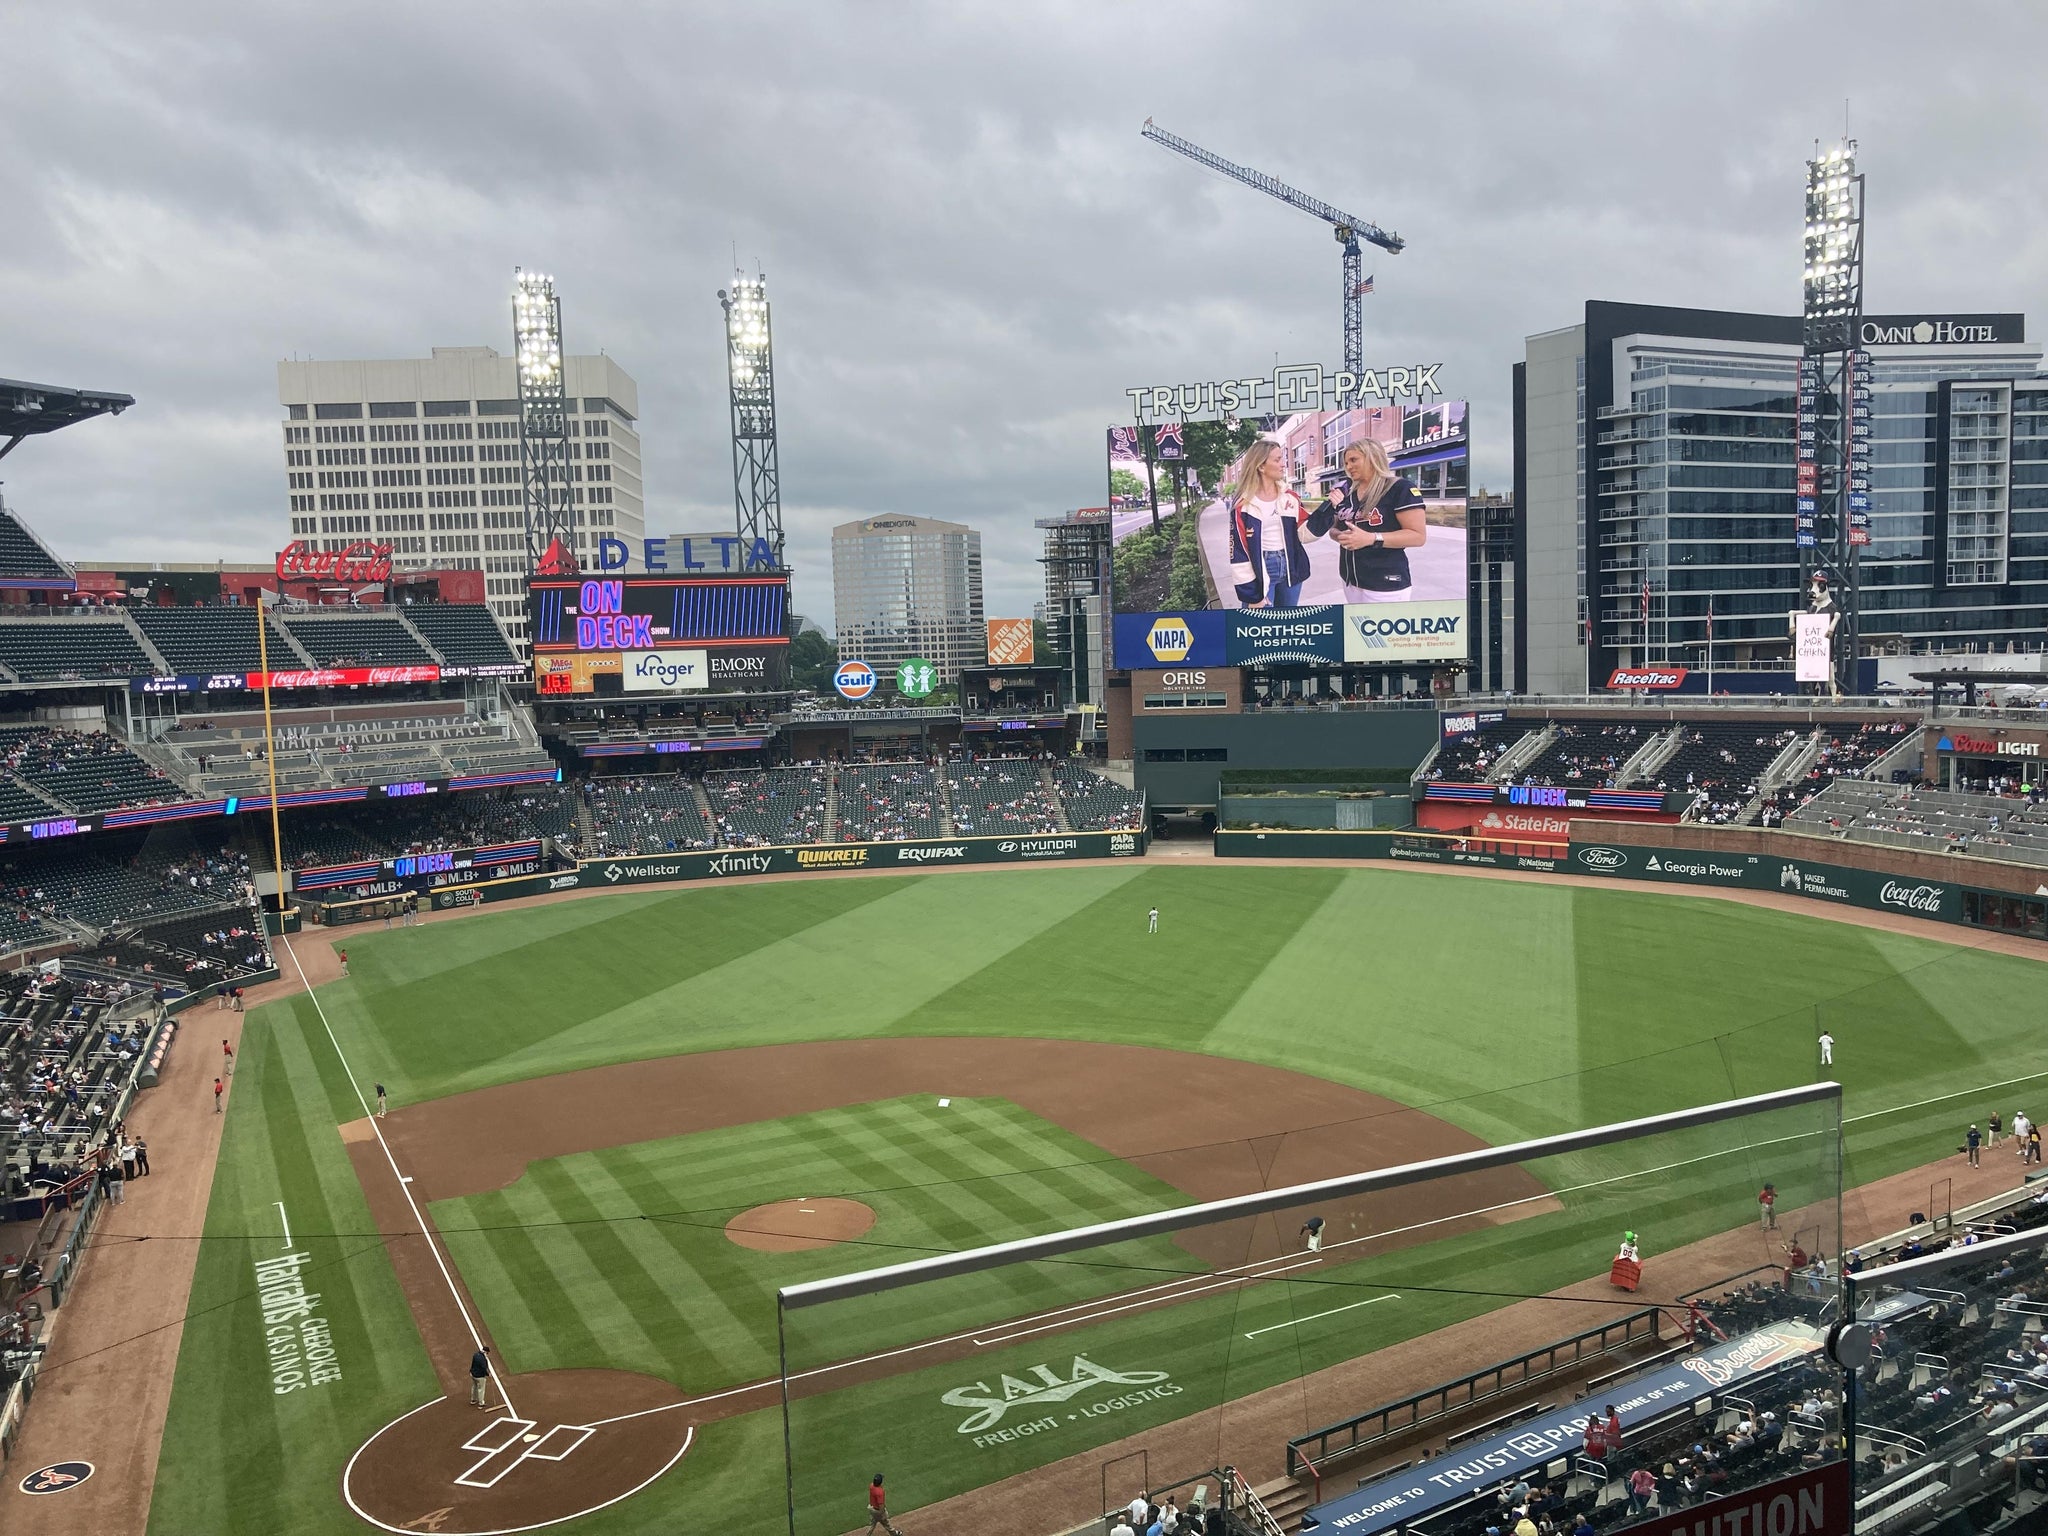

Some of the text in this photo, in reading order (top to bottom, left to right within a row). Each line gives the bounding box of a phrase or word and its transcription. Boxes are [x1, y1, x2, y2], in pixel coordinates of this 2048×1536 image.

[1862, 321, 1998, 345] OMNI HOTEL
[1854, 353, 1869, 363] 1873
[1801, 361, 1815, 370] 1872
[1853, 371, 1868, 381] 1875
[1126, 363, 1443, 418] TRUIST PARK
[1800, 396, 1815, 405] 1877
[1853, 407, 1868, 417] 1891
[1800, 431, 1815, 440] 1892
[1852, 426, 1868, 435] 1893
[1800, 484, 1814, 493] 1957
[1852, 479, 1867, 489] 1958
[1851, 497, 1867, 506] 1982
[1080, 509, 1109, 518] RaceTr
[1851, 514, 1867, 525] 1992
[1799, 518, 1813, 528] 1991
[1799, 536, 1814, 545] 1993
[1851, 532, 1867, 542] 1995
[600, 537, 778, 569] DELTA
[276, 540, 398, 581] Coca-Cola
[580, 580, 624, 615] ON
[565, 606, 578, 615] THE
[577, 614, 655, 649] DECK
[650, 626, 670, 635] SHOW
[1236, 623, 1333, 638] NORTHSIDE
[1361, 616, 1461, 636] COOLRAY
[1805, 626, 1821, 636] EAT
[993, 624, 1011, 641] THE
[990, 618, 1032, 663] HOME
[1155, 630, 1187, 650] NAPA
[1254, 637, 1315, 647] HOSPITAL
[1803, 637, 1822, 646] MOR
[1006, 636, 1032, 663] DEPOT
[1798, 647, 1827, 657] CHIKIN
[636, 654, 695, 685] Kroger
[711, 657, 766, 672] EMORY
[440, 667, 457, 677] 6:52
[458, 667, 470, 676] PM
[712, 671, 765, 679] HEALTHCARE
[1613, 672, 1677, 684] RaceTrac
[207, 680, 230, 689] 65.3
[546, 675, 571, 688] 163
[837, 674, 873, 686] Gulf
[1162, 672, 1206, 685] ORIS
[143, 682, 161, 691] 6.6
[1445, 717, 1476, 726] BRAVES
[1445, 723, 1476, 733] VISION
[656, 743, 669, 753] ON
[669, 741, 690, 752] DECK
[1954, 733, 2040, 756] Coors LIGHT
[387, 784, 401, 797] ON
[402, 782, 426, 796] DECK
[1499, 786, 1586, 808] THE ON DECK SHOW
[32, 823, 48, 839] ON
[49, 820, 77, 837] DECK
[1110, 834, 1134, 843] PAPA
[1021, 839, 1077, 851] HYUNDAI
[1110, 843, 1135, 851] JOHNS
[797, 849, 868, 863] QUIKRETE
[898, 847, 964, 861] EQUIFAX
[1586, 850, 1618, 866] Ford
[383, 853, 473, 877] THE ON DECK SHOW
[510, 862, 540, 875] MLB+
[709, 853, 772, 876] xfinity
[1526, 859, 1555, 868] National
[1664, 861, 1744, 877] Georgia Power
[625, 864, 680, 878] Wellstar
[1804, 873, 1826, 884] KAISER
[370, 881, 403, 895] MLB+
[455, 889, 474, 898] SOUT
[1804, 883, 1848, 898] PERMANENTE
[455, 893, 484, 903] COLLE
[1880, 880, 1945, 912] Coca-Cola
[300, 1317, 342, 1386] CHEROKEE
[266, 1325, 307, 1395] CASINOS
[1681, 1332, 1780, 1387] Braves
[941, 1352, 1170, 1434] SAIA
[972, 1382, 1184, 1449] FREIGHT LOGISTICS
[1331, 1495, 1407, 1529] WELCOME
[1402, 1487, 1426, 1500] TO
[1428, 1448, 1518, 1489] TRUIST
[1614, 1395, 1651, 1414] HOME
[1647, 1389, 1665, 1399] OF
[1662, 1381, 1691, 1393] THE
